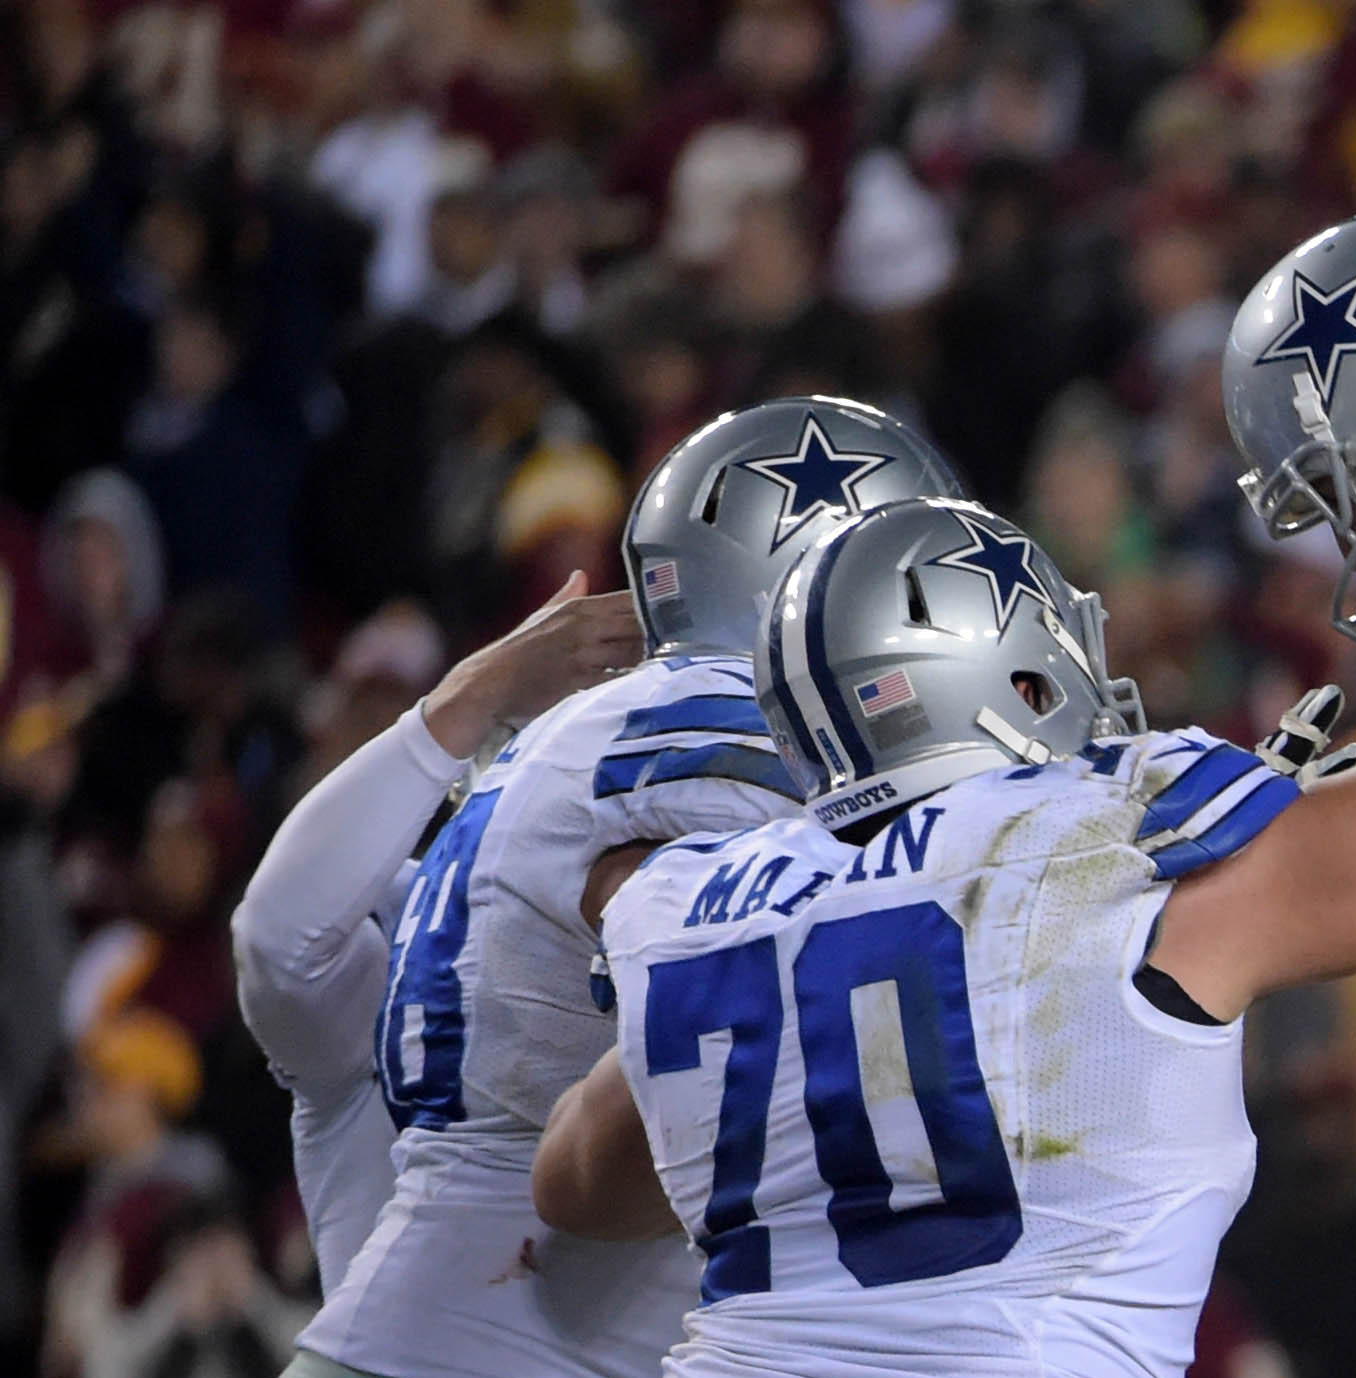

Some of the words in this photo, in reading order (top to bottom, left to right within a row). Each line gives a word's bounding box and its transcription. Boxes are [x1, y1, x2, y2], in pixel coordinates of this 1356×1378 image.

[813, 781, 898, 826] COWBOYS
[684, 807, 946, 928] MAIN
[645, 900, 1023, 1308] 70
